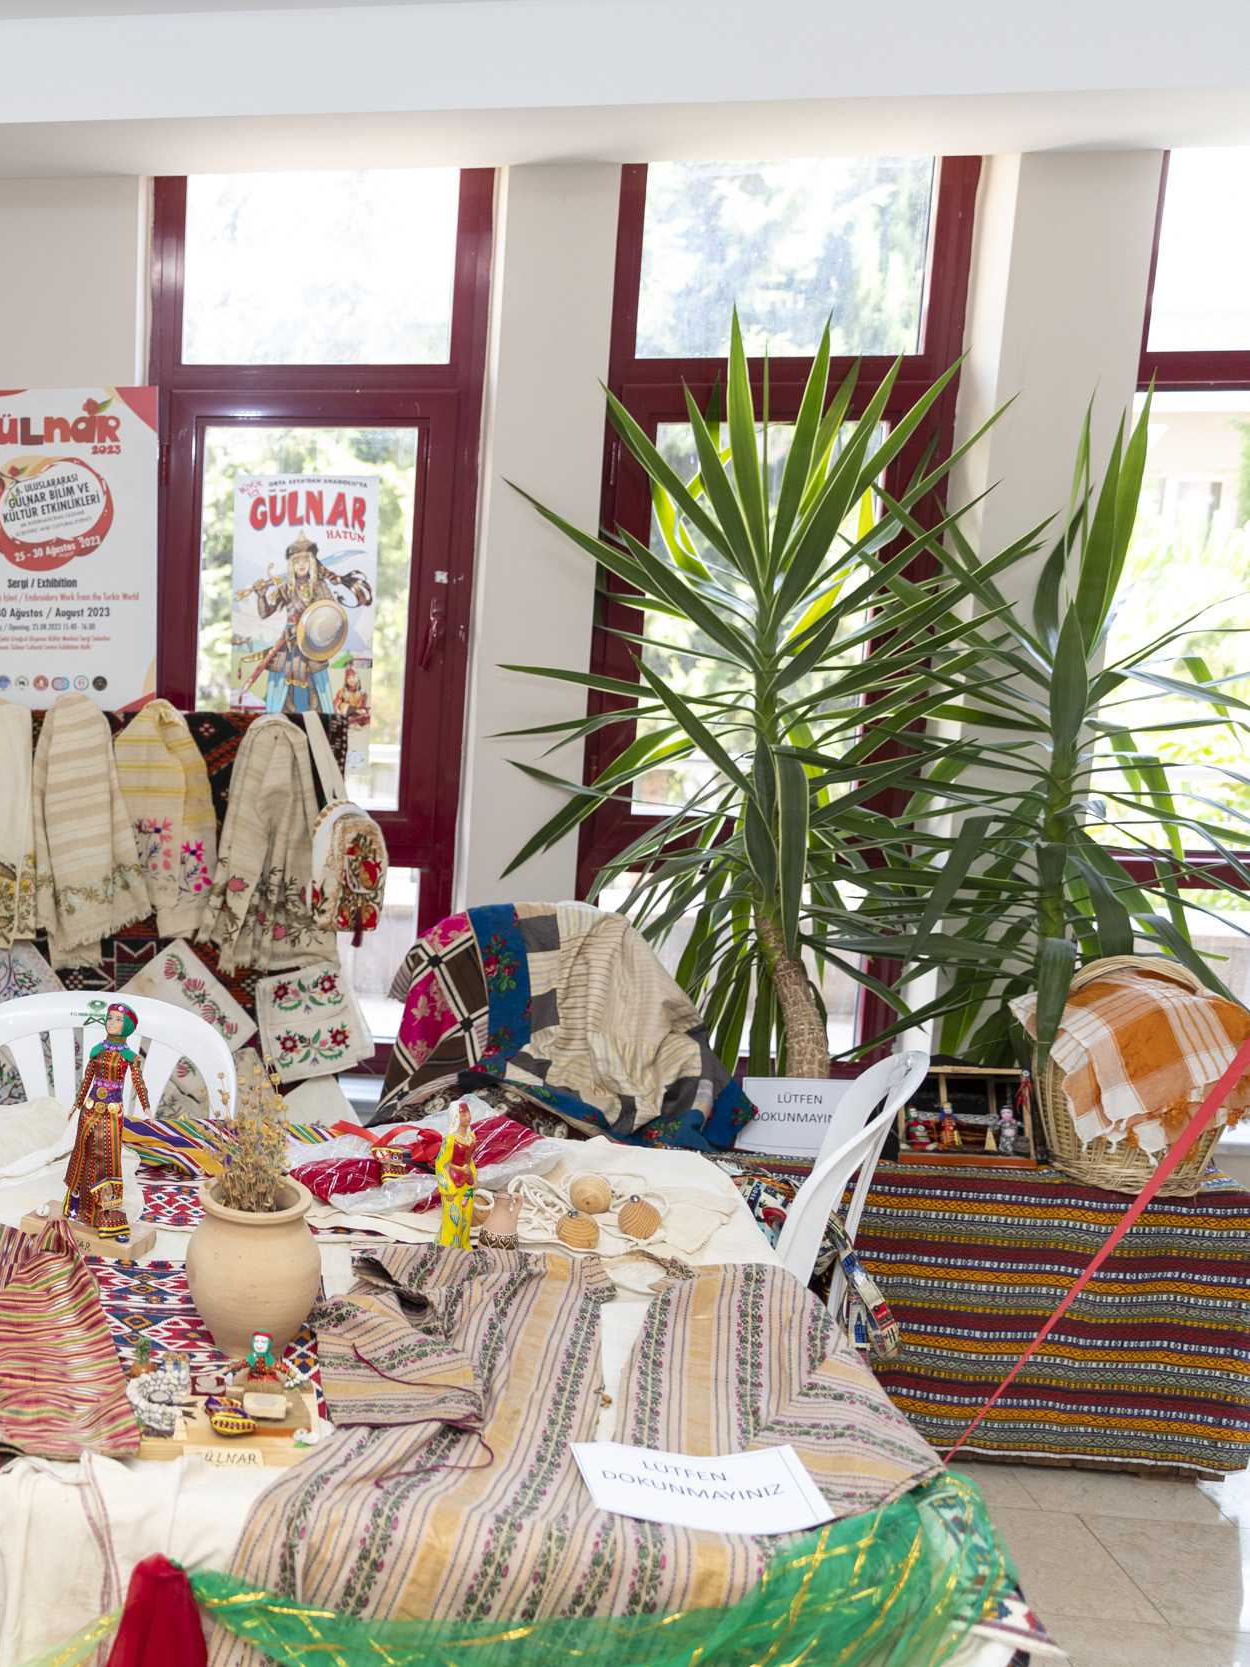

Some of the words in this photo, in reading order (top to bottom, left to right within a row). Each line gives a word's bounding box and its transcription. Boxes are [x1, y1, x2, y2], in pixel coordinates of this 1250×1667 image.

[91, 445, 121, 454] 2023
[24, 474, 78, 493] ULUSLARARASI
[324, 479, 368, 488] ANADOLU'YA
[9, 491, 46, 508] GÜLNAR
[49, 484, 75, 500] BİLİM
[77, 482, 90, 494] VE
[2, 505, 38, 523] KÜLTÜR
[41, 490, 100, 515] ETKİNLİKLERİ
[249, 488, 366, 532] GÜLNAR
[326, 530, 365, 543] HATUN
[14, 551, 26, 562] 25
[32, 548, 43, 558] 30
[46, 542, 76, 557] Ağustos
[80, 536, 102, 548] 2023
[7, 578, 28, 589] Sergi
[38, 578, 77, 588] Exhibition
[25, 592, 58, 602] Embroidery
[76, 592, 90, 600] from
[92, 592, 102, 600] the
[122, 592, 140, 600] World
[10, 608, 43, 620] Ağustos
[55, 608, 84, 620] August
[87, 607, 110, 617] 2023
[778, 1092, 823, 1104] LÜTFEN
[642, 1460, 727, 1482] LÜTFEN
[602, 1470, 785, 1500] DOKUNMAYINIZ
